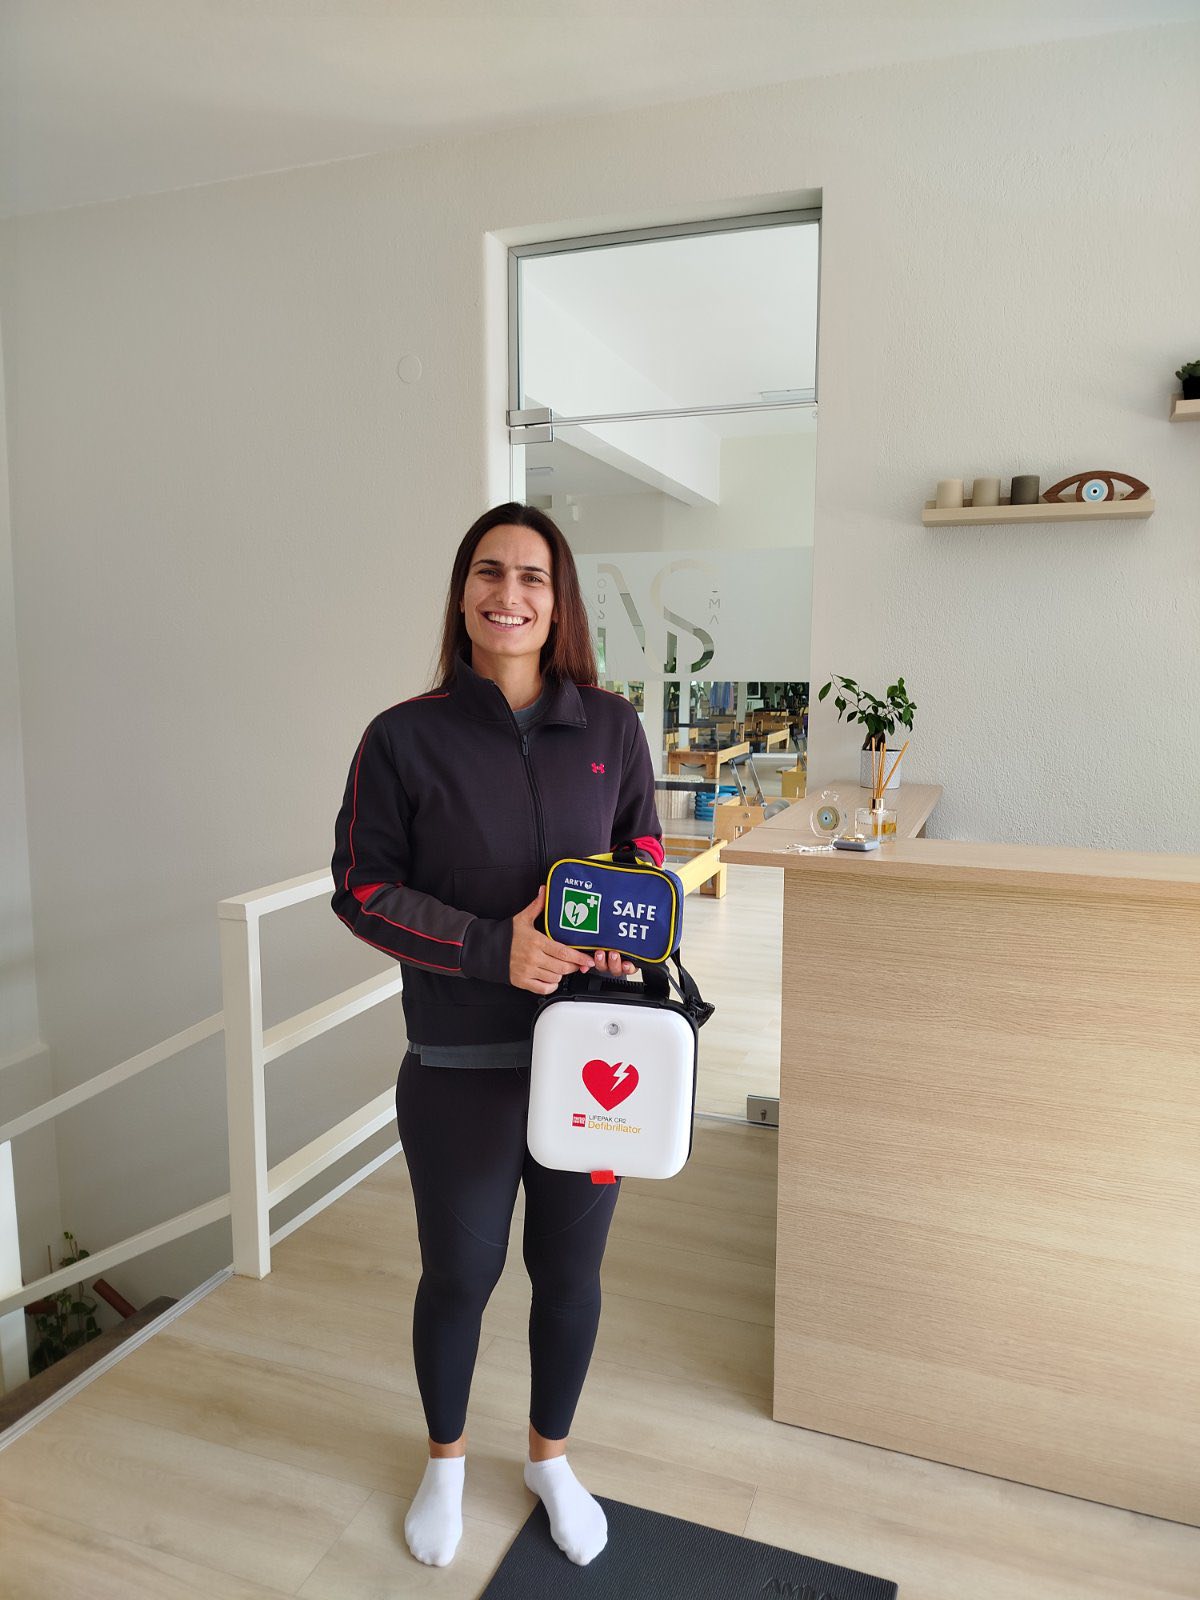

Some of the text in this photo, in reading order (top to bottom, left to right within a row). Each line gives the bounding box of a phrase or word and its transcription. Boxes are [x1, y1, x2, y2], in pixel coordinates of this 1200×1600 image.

[564, 878, 584, 888] ARKY
[612, 900, 657, 921] SAFE
[618, 922, 650, 940] SET
[588, 1115, 613, 1123] LIFEPAK
[588, 1121, 642, 1134] Defibrillator
